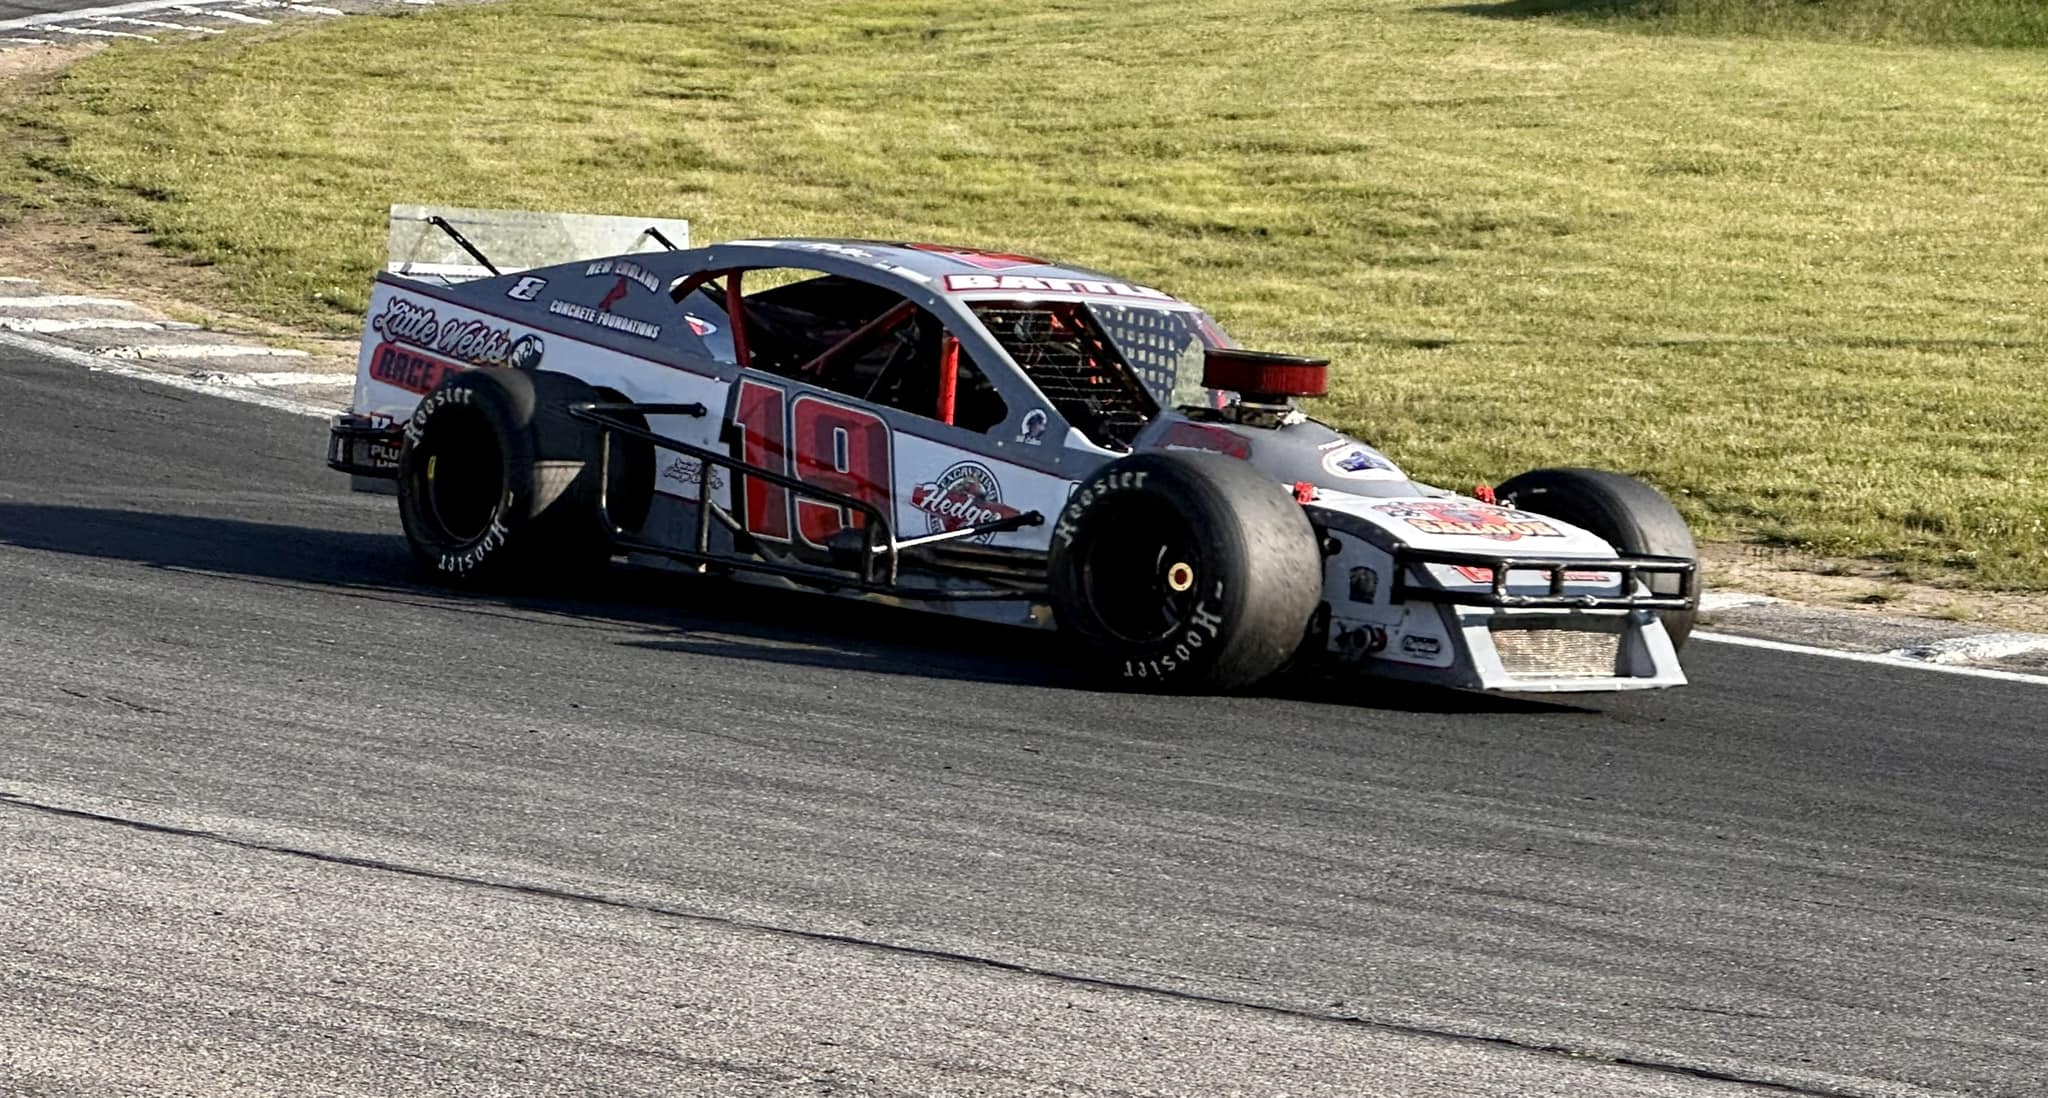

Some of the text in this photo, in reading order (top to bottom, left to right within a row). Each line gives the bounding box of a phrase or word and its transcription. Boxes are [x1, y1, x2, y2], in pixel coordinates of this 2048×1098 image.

[585, 261, 661, 294] NEW ENGLAND
[373, 296, 438, 344] Little
[550, 300, 662, 340] CONCRETE FOUNDATIONS
[379, 347, 434, 387] RACE
[404, 383, 474, 449] Hoosier
[370, 444, 400, 461] PLU
[730, 377, 896, 553] 19
[1054, 469, 1149, 548] Hoosier
[438, 516, 509, 576] Hoosier
[1123, 600, 1222, 681] Hoosier
